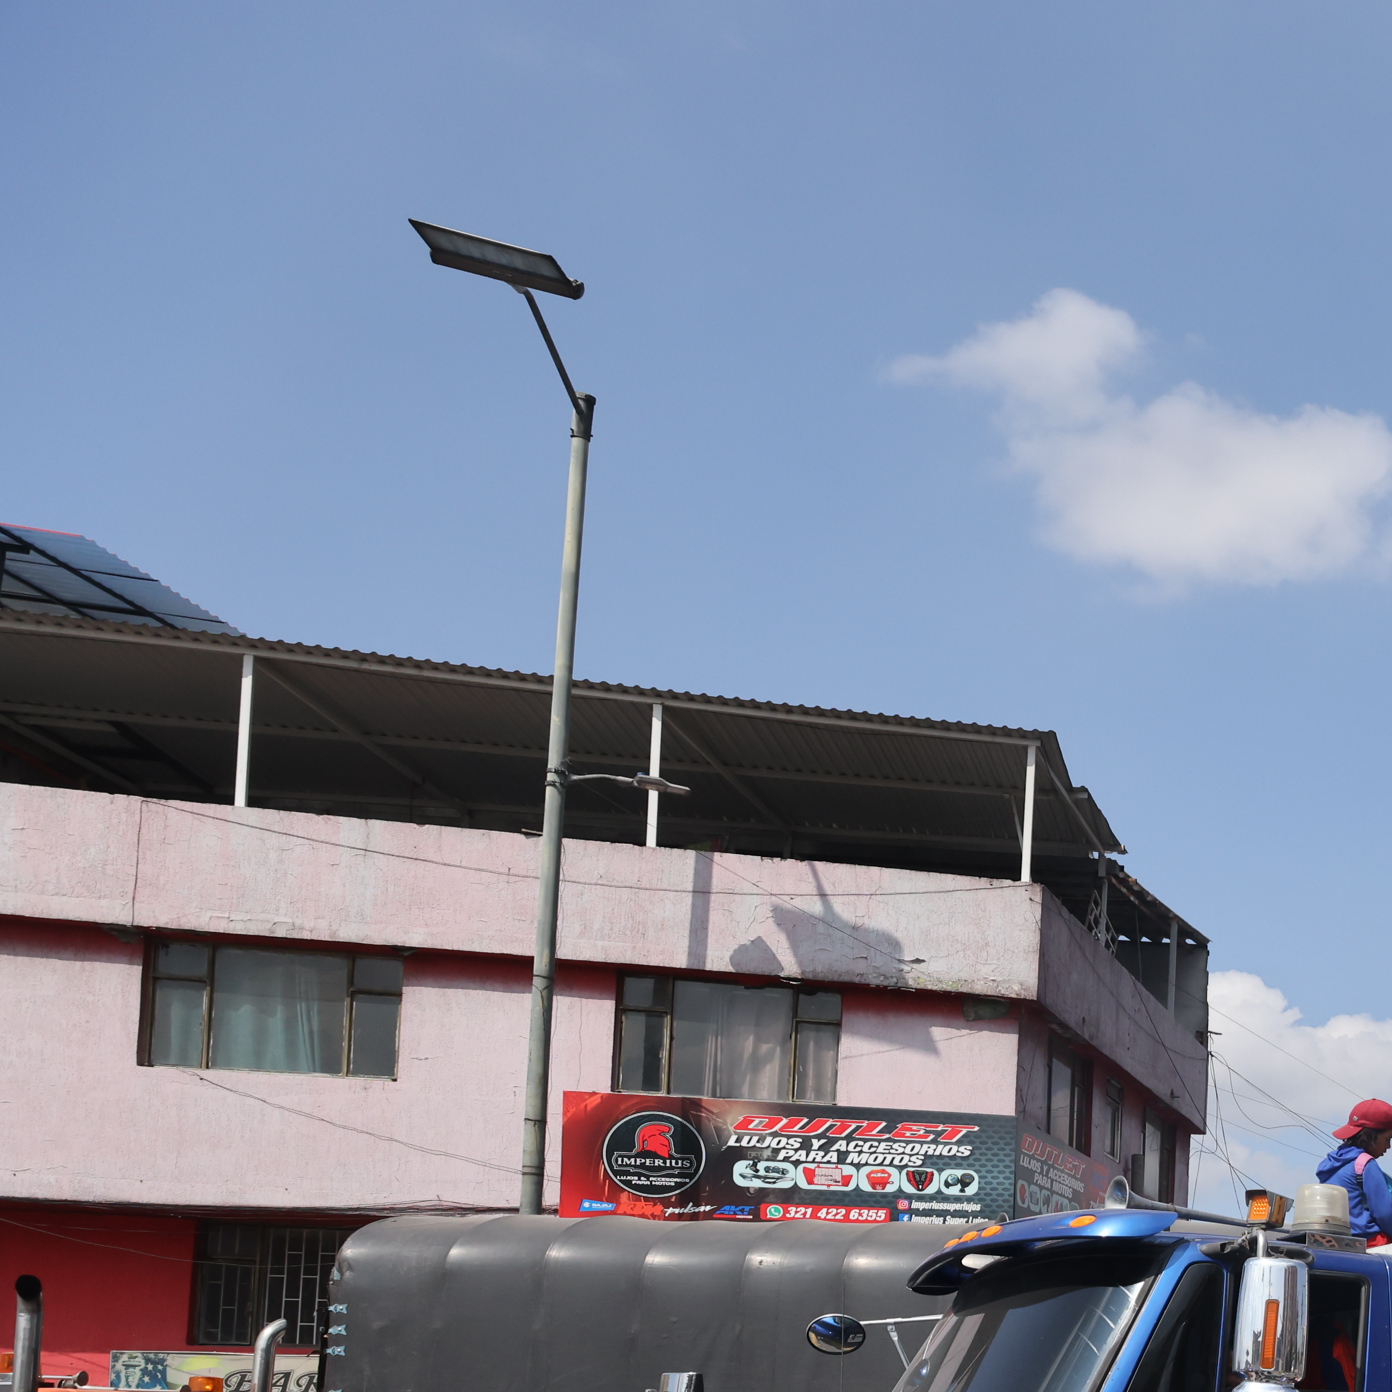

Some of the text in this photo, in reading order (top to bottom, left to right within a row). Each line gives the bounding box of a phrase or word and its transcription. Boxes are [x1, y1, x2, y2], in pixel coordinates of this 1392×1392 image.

[732, 1114, 980, 1143] OUTLET
[727, 1135, 973, 1157] LUJOS Y ACCESORIOS
[1021, 1133, 1086, 1178] OUTLET
[616, 1156, 691, 1168] IMPERIUS
[776, 1149, 925, 1166] PARA MOTOS
[1020, 1154, 1085, 1193] LUJOS Y ACCESORIOS
[1033, 1173, 1074, 1198] PARA MOTOS
[714, 1205, 756, 1215] AKT
[785, 1206, 887, 1221] 321 422 6355
